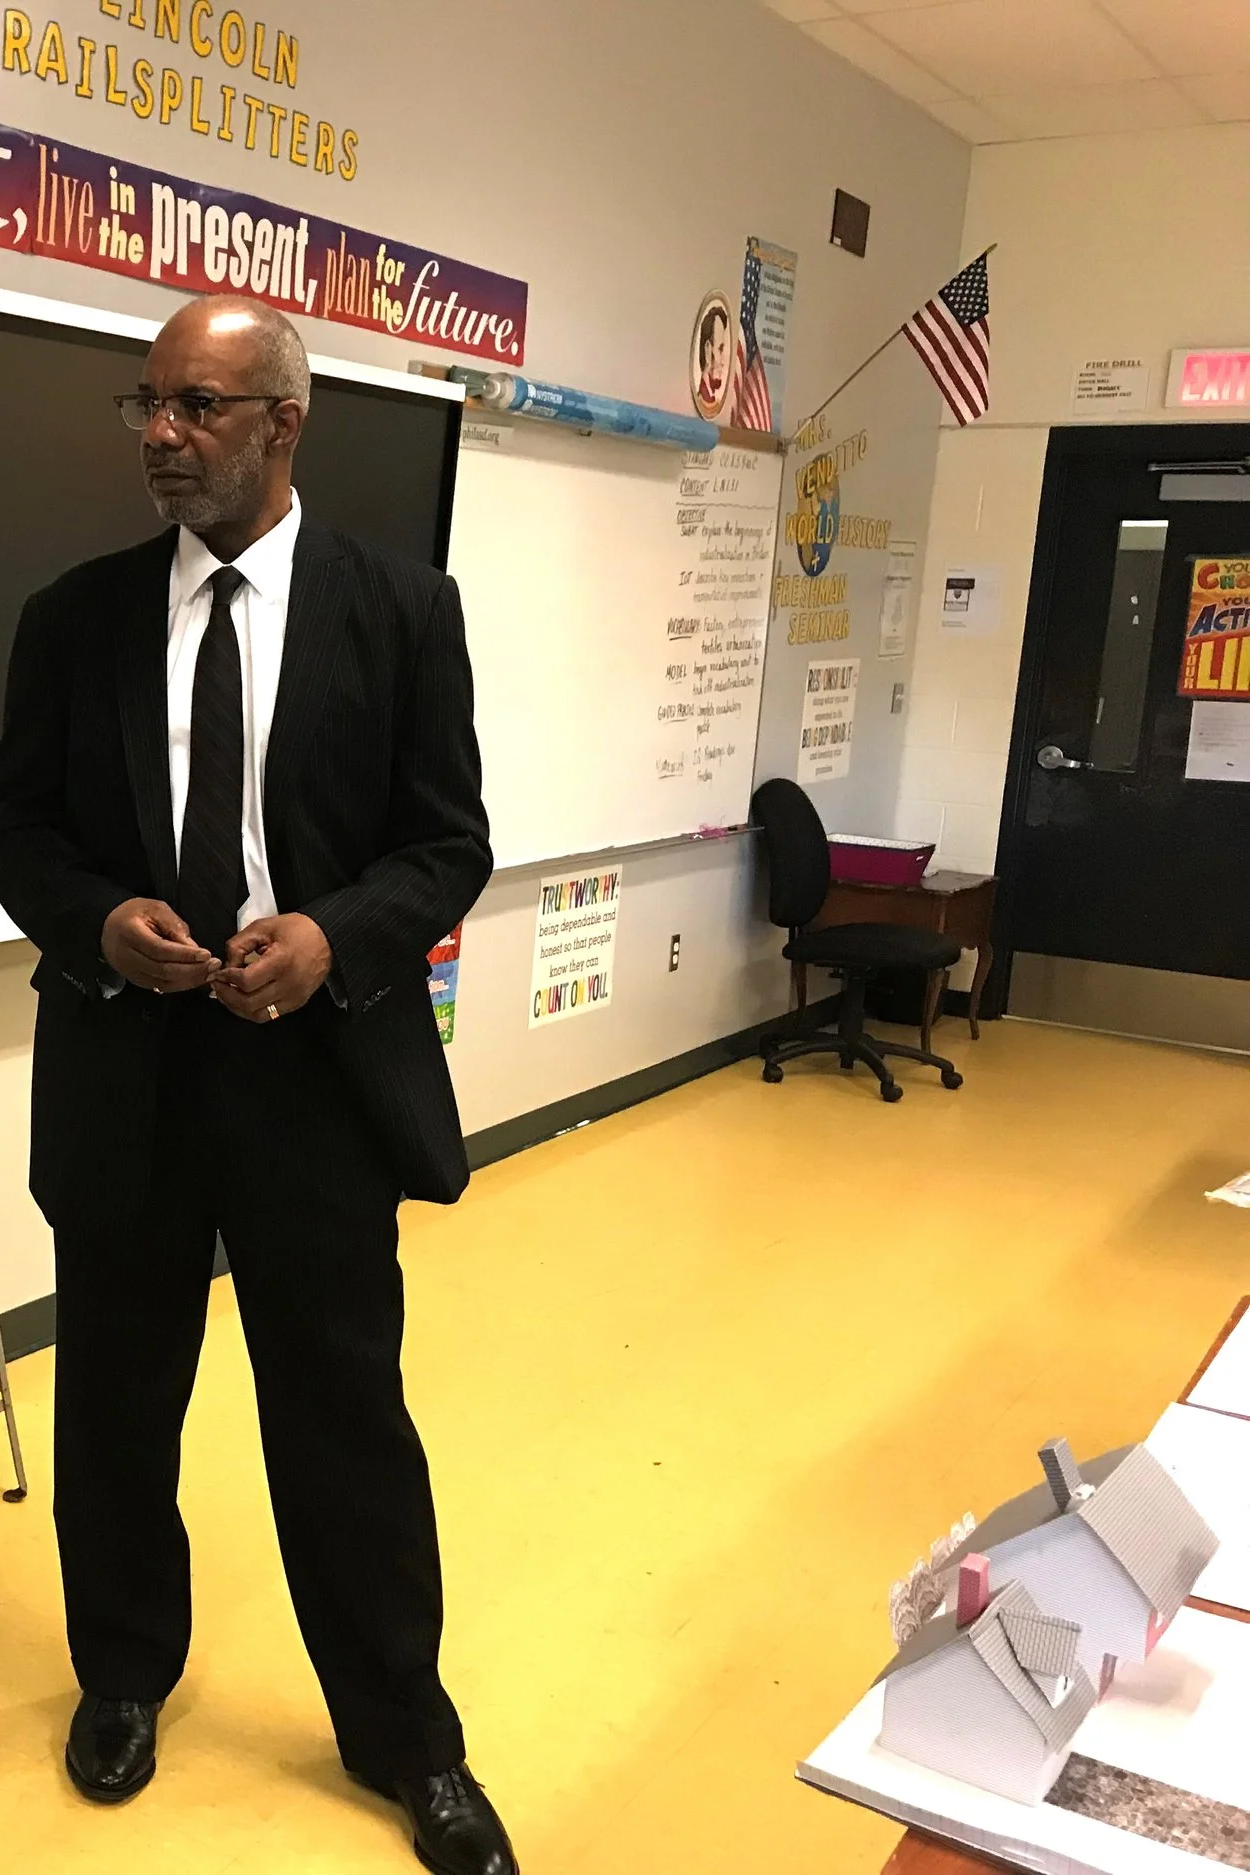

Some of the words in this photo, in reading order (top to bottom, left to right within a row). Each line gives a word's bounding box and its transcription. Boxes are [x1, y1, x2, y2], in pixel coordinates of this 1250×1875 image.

[2, 8, 359, 182] RAILSPLITTERS
[36, 143, 95, 254] live
[110, 165, 137, 216] in
[98, 213, 144, 264] the
[150, 181, 319, 313] present,
[324, 230, 371, 318] plan
[376, 244, 405, 283] for
[372, 286, 404, 326] the
[387, 259, 520, 357] future.
[1085, 360, 1109, 369] FIRE
[1111, 359, 1143, 369] DRILL
[462, 425, 500, 446] philasd.org
[795, 428, 868, 499] VENDITTO
[784, 512, 834, 546] WORLD
[837, 514, 893, 549] HISTORY
[773, 573, 849, 609] FRESHMAN
[787, 610, 850, 646] SEMINAR
[542, 872, 620, 915] TRUSTWORTHY:
[539, 922, 559, 937] being
[560, 912, 602, 932] dependable
[602, 908, 616, 922] and
[540, 942, 563, 959] honest
[564, 942, 572, 953] so
[573, 938, 587, 951] that
[588, 930, 612, 949] people
[549, 964, 568, 978] know
[569, 958, 585, 972] they
[585, 955, 599, 967] can
[533, 982, 569, 1019] COUNT
[570, 980, 585, 1008] ON
[587, 972, 609, 1003] YOU.
